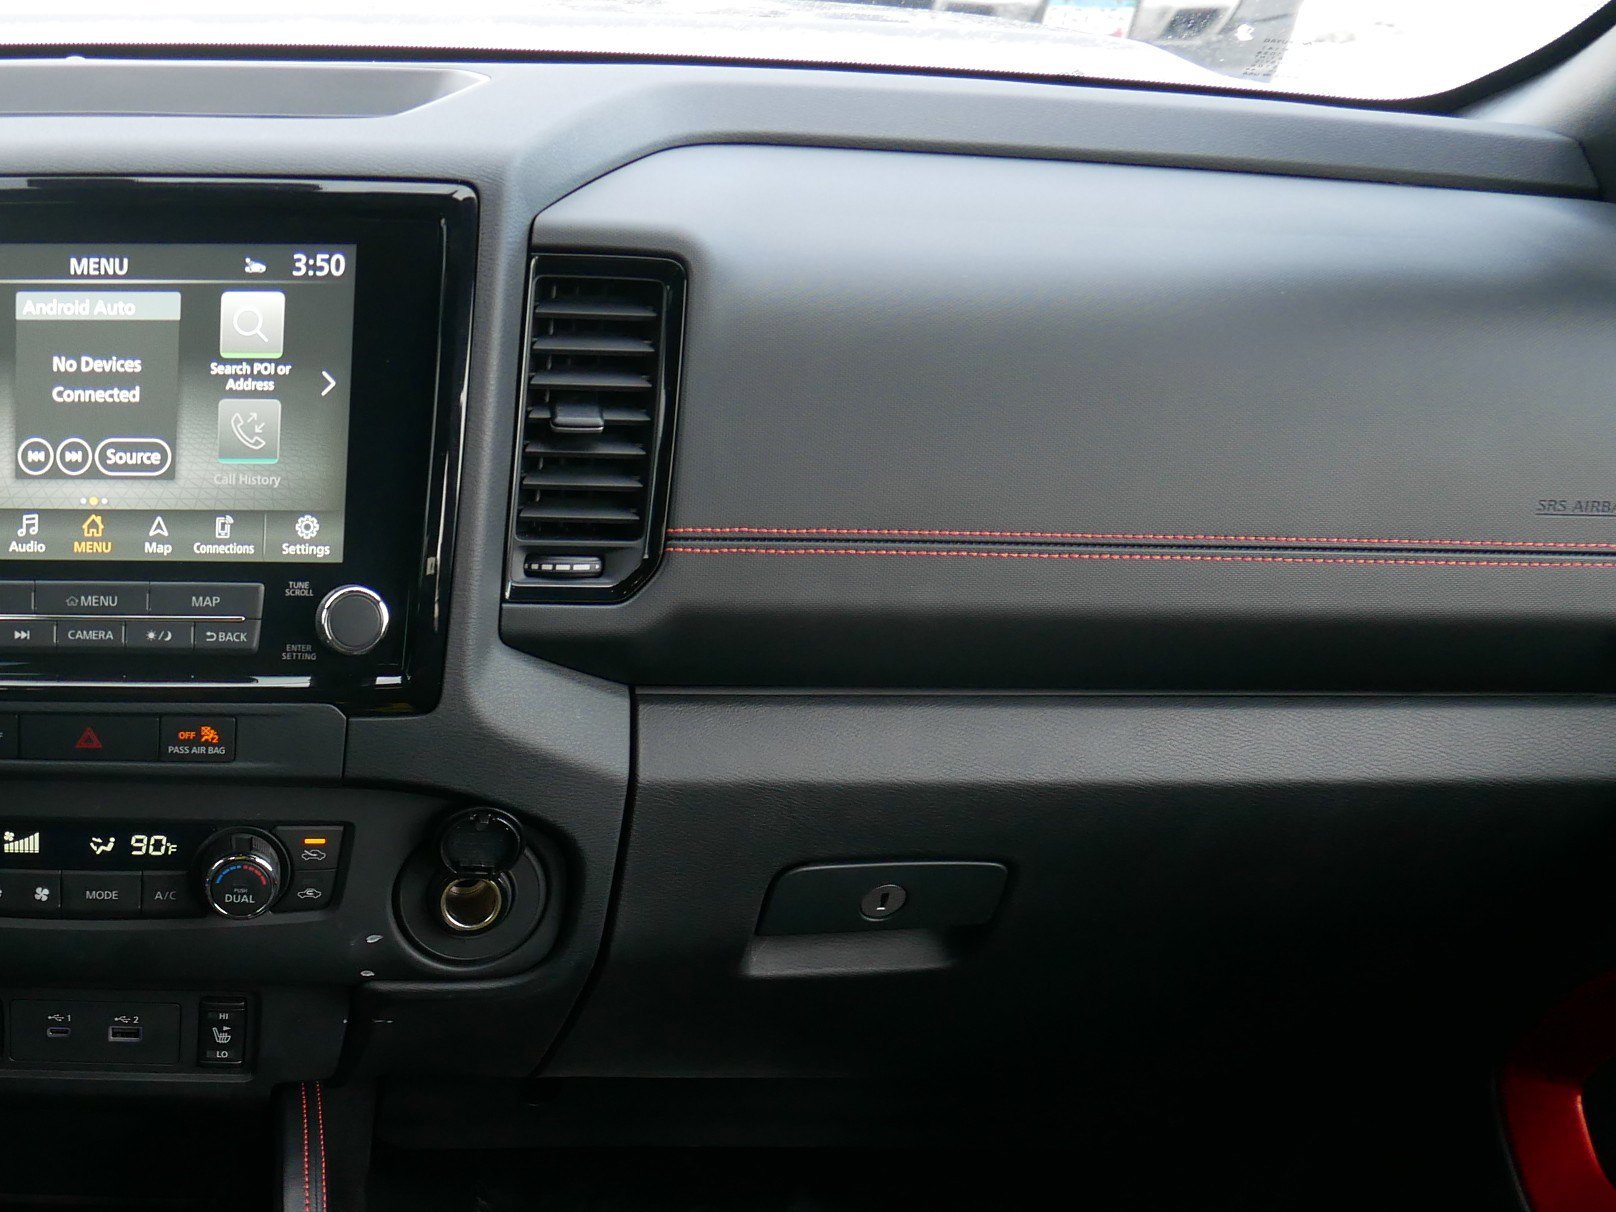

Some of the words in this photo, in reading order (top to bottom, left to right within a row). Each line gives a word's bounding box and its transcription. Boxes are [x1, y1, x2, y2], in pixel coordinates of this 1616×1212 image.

[70, 257, 128, 275] MENU
[292, 254, 346, 277] 3:50
[22, 299, 89, 316] Android
[93, 300, 137, 316] Auto
[52, 356, 77, 373] No
[81, 356, 142, 373] Devices
[210, 362, 251, 375] Search
[253, 362, 275, 375] POI
[277, 365, 292, 375] or
[225, 378, 275, 391] Address
[52, 386, 140, 403] Connected
[106, 449, 161, 465] Source
[214, 474, 236, 486] Call
[239, 474, 281, 488] History
[1537, 500, 1567, 512] SRS
[9, 540, 46, 553] Audio
[73, 541, 112, 553] MENU
[144, 542, 172, 556] Map
[193, 542, 255, 555] Connections
[282, 543, 331, 557] Settings
[288, 581, 310, 589] TUNE
[285, 589, 314, 597] SCROLL
[80, 596, 118, 607] MENU
[191, 596, 221, 607] MAP
[67, 630, 114, 640] CAMERA
[218, 632, 247, 642] BACK
[285, 644, 312, 652] ENTER
[282, 652, 317, 661] SETTING
[178, 731, 196, 740] OFF
[168, 746, 190, 754] PASS
[191, 746, 207, 754] AIR
[208, 746, 226, 755] BAG
[86, 890, 119, 900] MODE
[154, 891, 177, 900] A/C
[225, 894, 256, 904] DUAL
